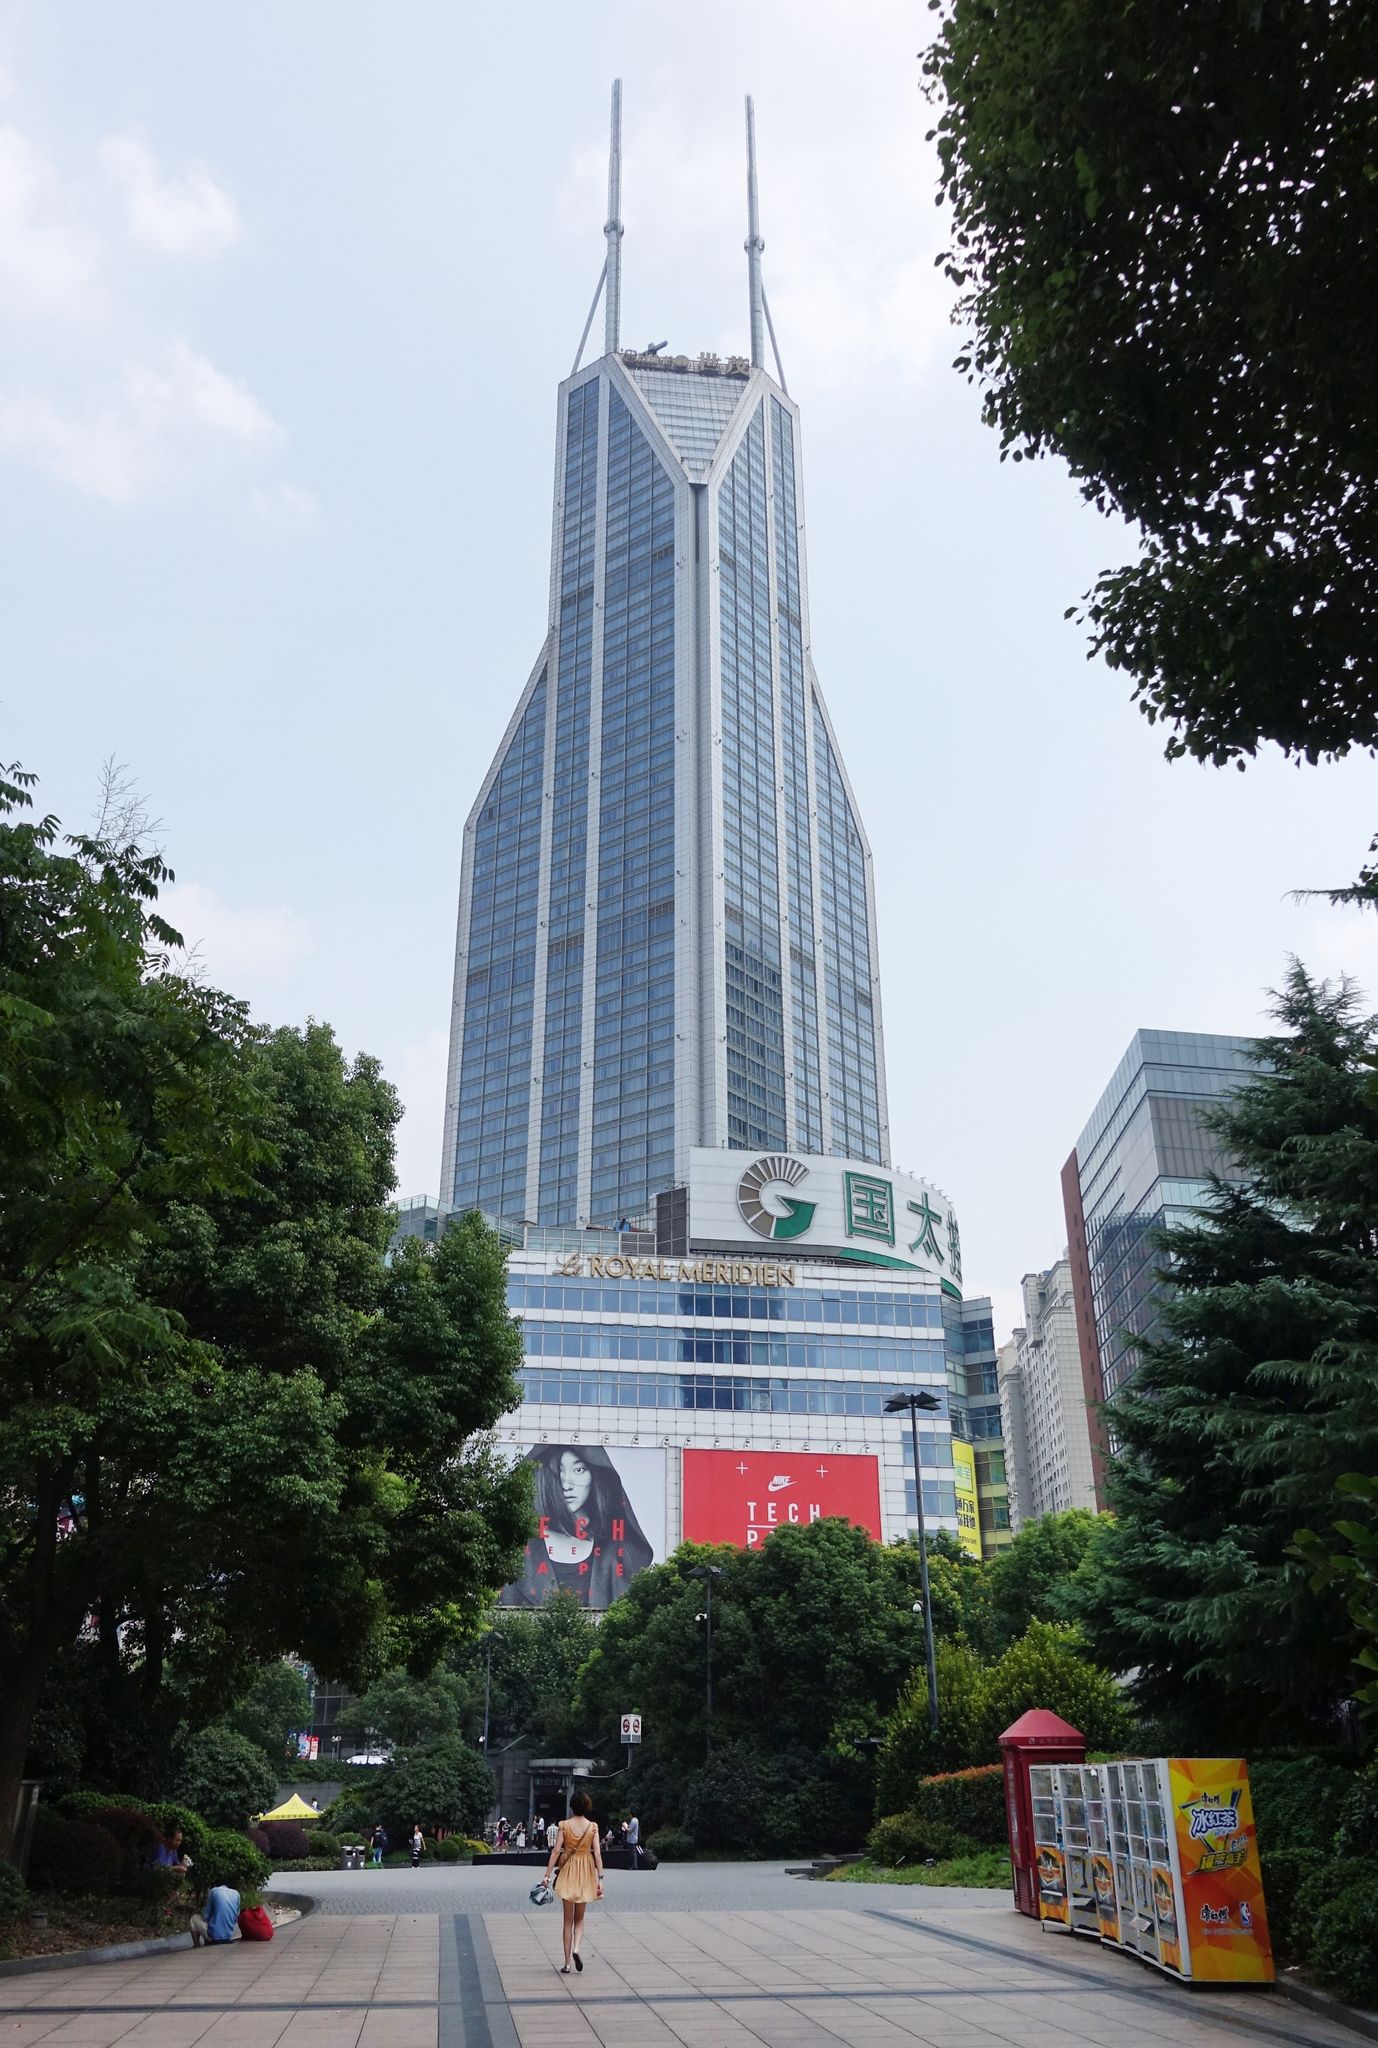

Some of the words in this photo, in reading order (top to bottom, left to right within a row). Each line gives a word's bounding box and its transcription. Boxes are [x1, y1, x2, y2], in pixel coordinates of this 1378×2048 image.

[553, 1253, 584, 1276] Le
[590, 1254, 672, 1281] ROYAL
[772, 1475, 791, 1485] NIKE
[747, 1502, 821, 1524] TECH
[1191, 1808, 1237, 1838] 冰红茶
